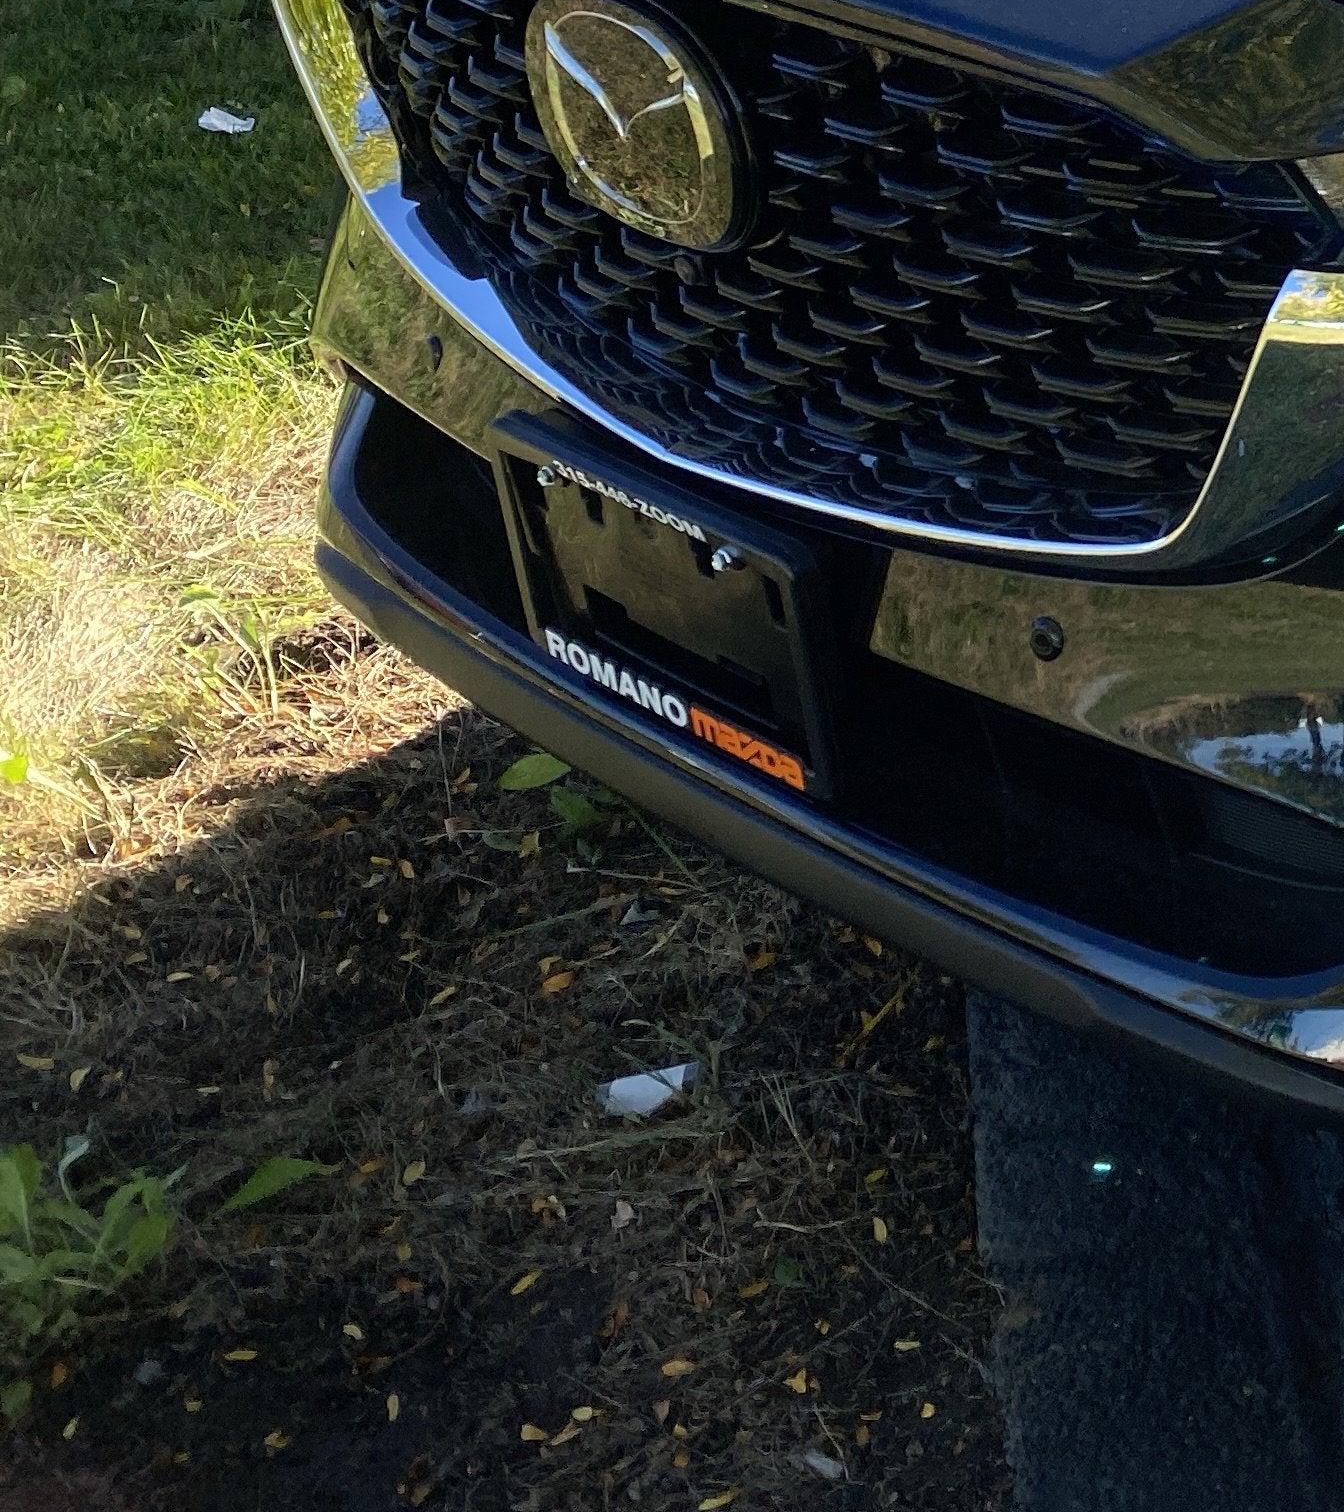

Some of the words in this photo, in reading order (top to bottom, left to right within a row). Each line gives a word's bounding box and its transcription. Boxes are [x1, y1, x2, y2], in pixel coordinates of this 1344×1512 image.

[552, 459, 708, 544] 315-446-ZOOM
[545, 629, 689, 728] ROMANO
[690, 705, 806, 792] mazda
